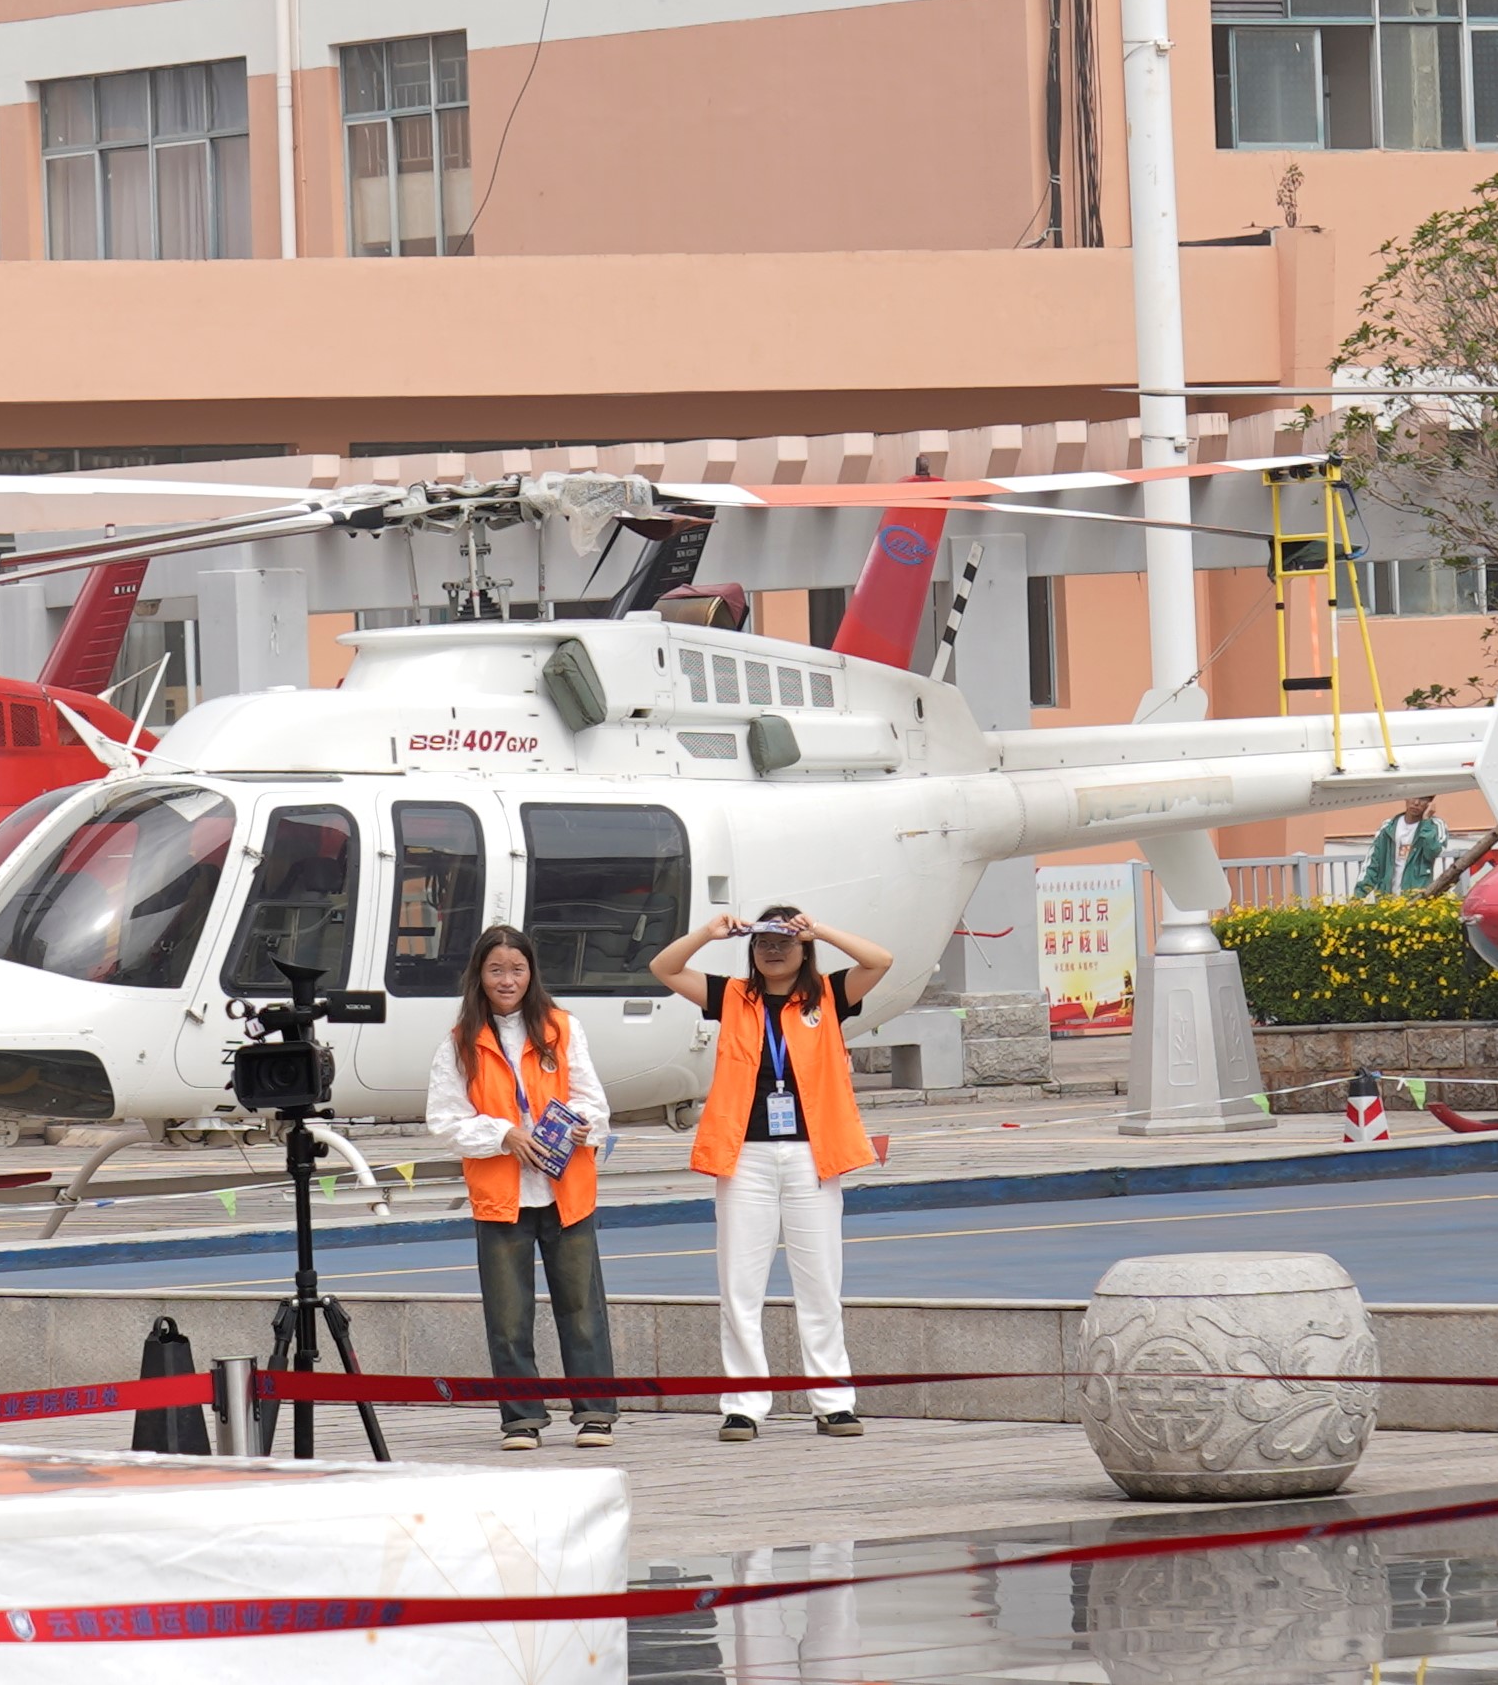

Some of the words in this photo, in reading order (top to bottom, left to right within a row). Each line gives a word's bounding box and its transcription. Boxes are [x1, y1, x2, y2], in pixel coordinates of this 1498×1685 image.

[1044, 898, 1109, 924] 心向北京
[1044, 930, 1109, 955] 拥护核心
